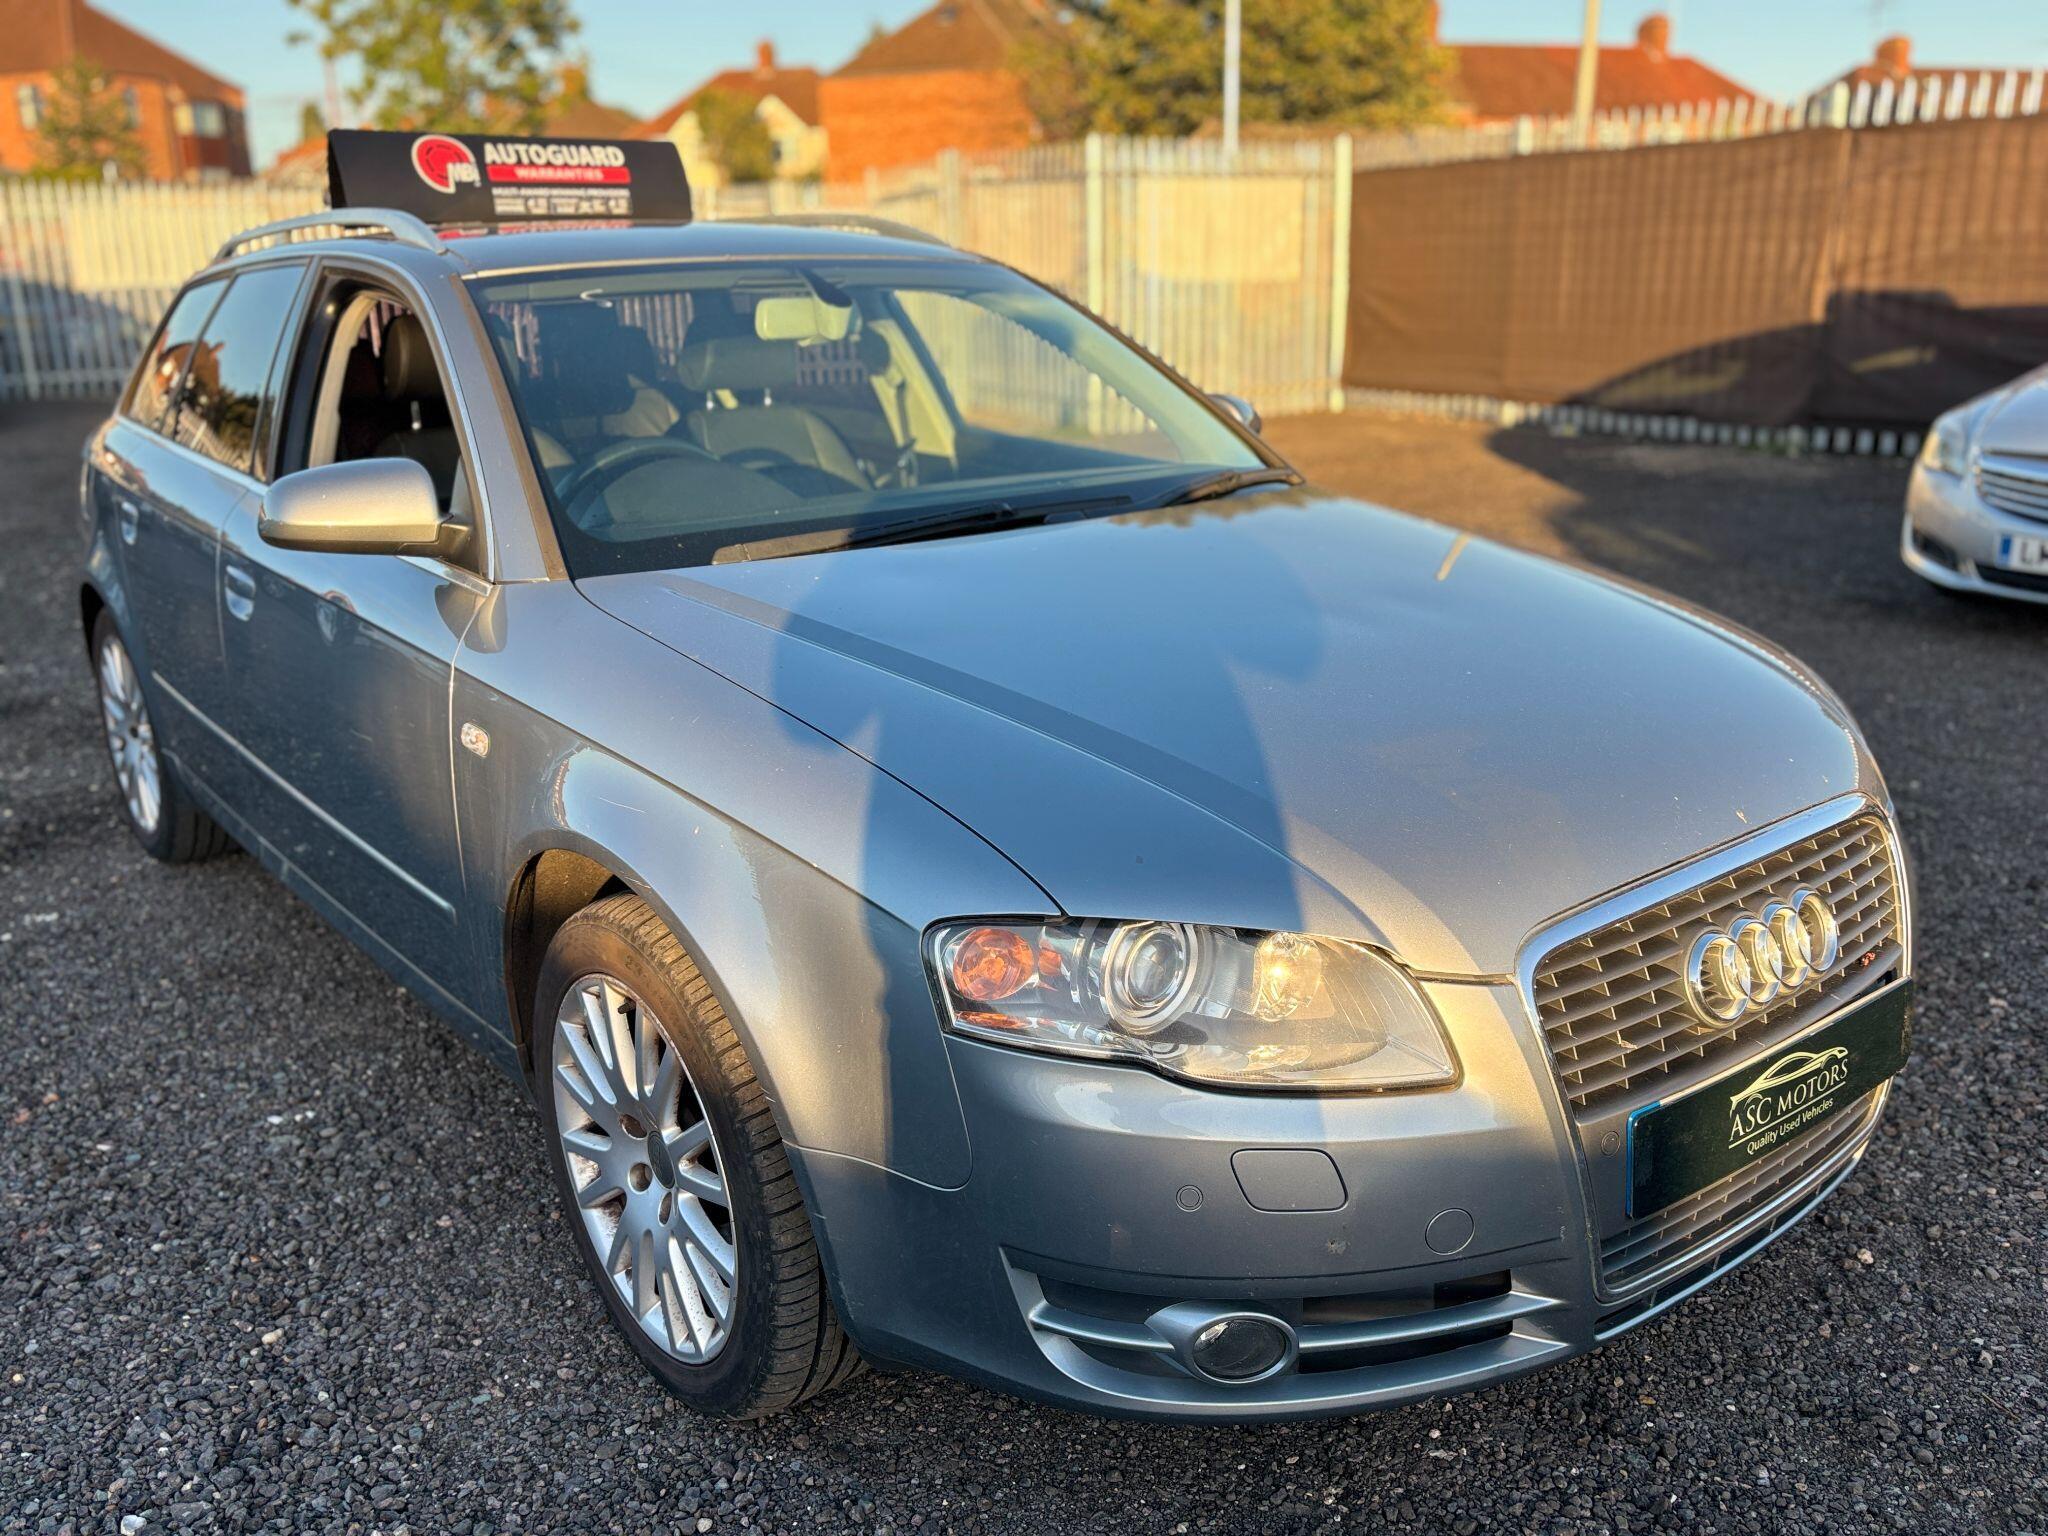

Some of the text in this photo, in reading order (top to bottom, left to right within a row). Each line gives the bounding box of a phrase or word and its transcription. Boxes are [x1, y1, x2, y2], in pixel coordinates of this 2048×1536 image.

[484, 142, 625, 167] AUTOGUARD
[515, 166, 605, 181] WARRANTIES
[1729, 1058, 1848, 1142] ASC MOTORS
[1747, 1098, 1834, 1155] Quality Used Vehicles
